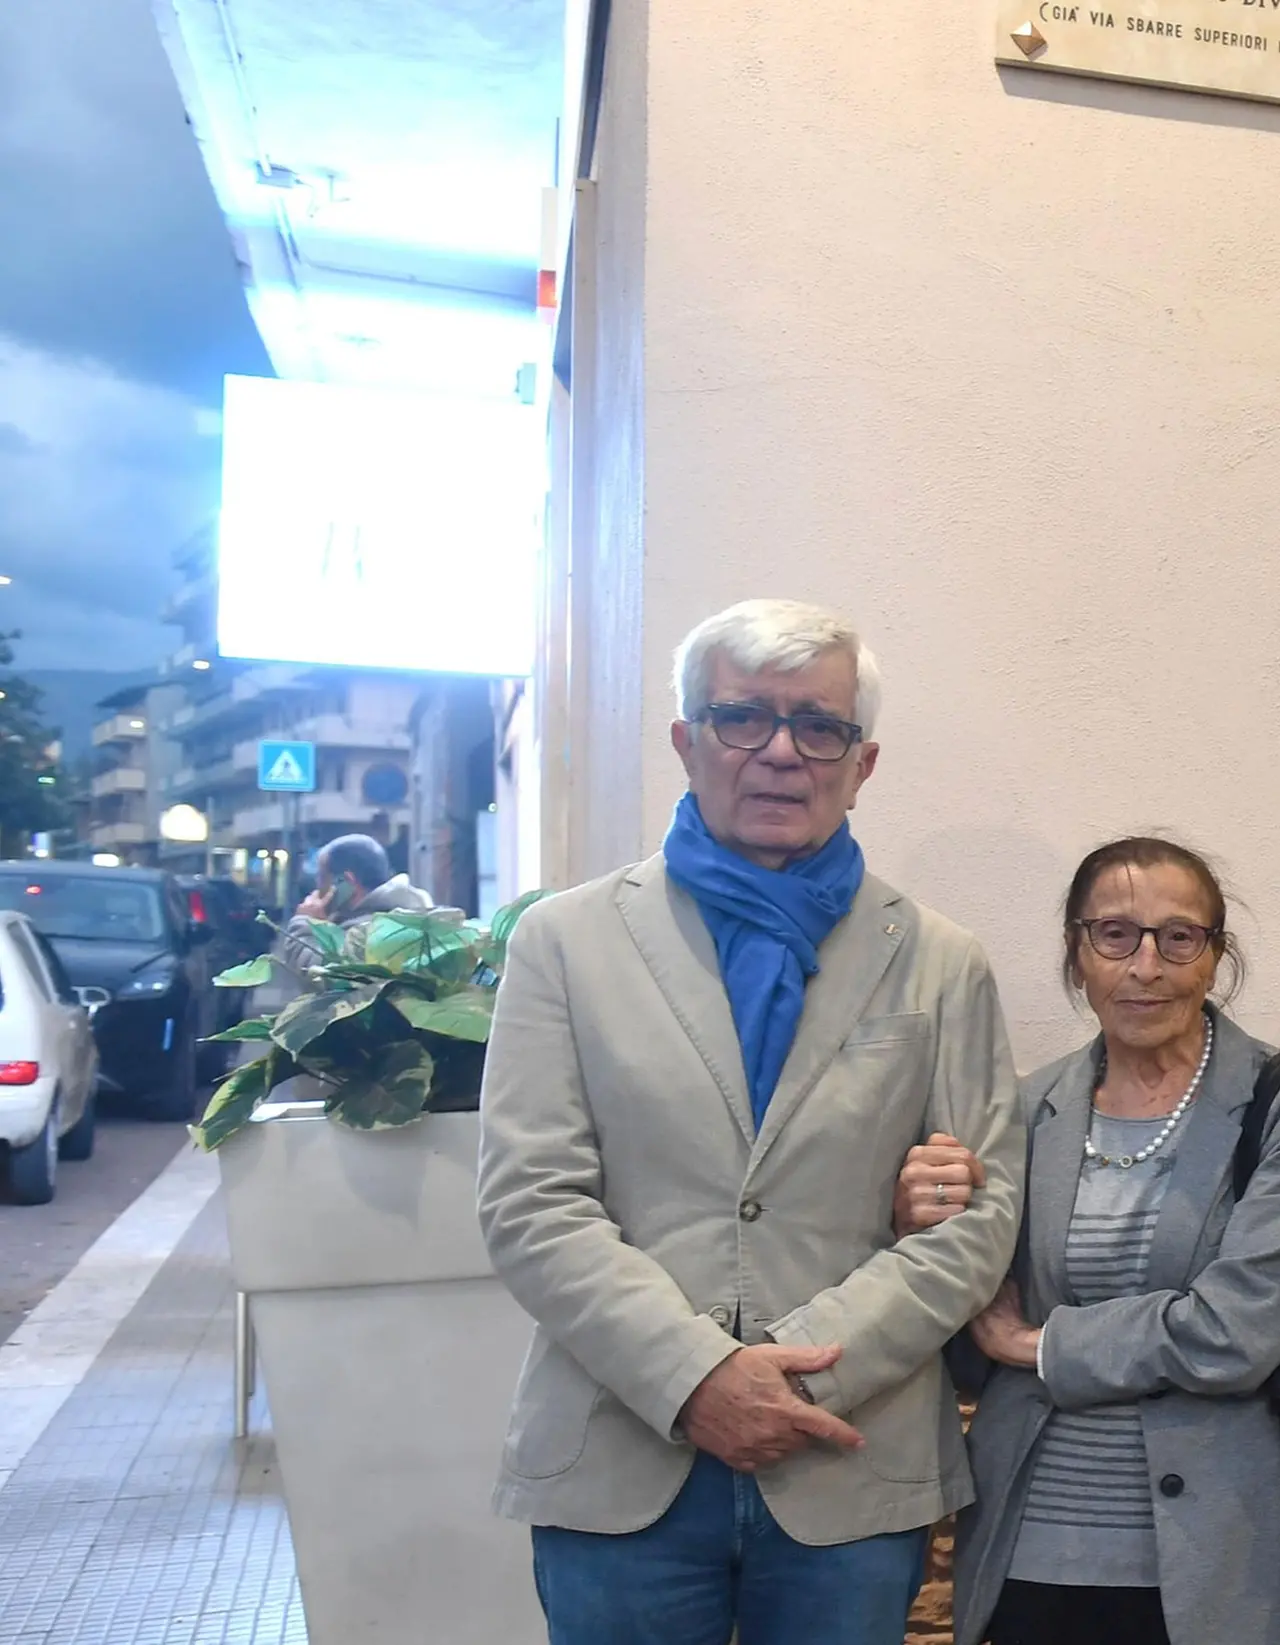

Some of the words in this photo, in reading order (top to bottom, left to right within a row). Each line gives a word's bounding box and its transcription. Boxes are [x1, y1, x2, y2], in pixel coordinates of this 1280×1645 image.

[1090, 11, 1115, 28] VIA
[1127, 17, 1184, 38] SBARRE
[1194, 27, 1267, 51] SUPERIORI
